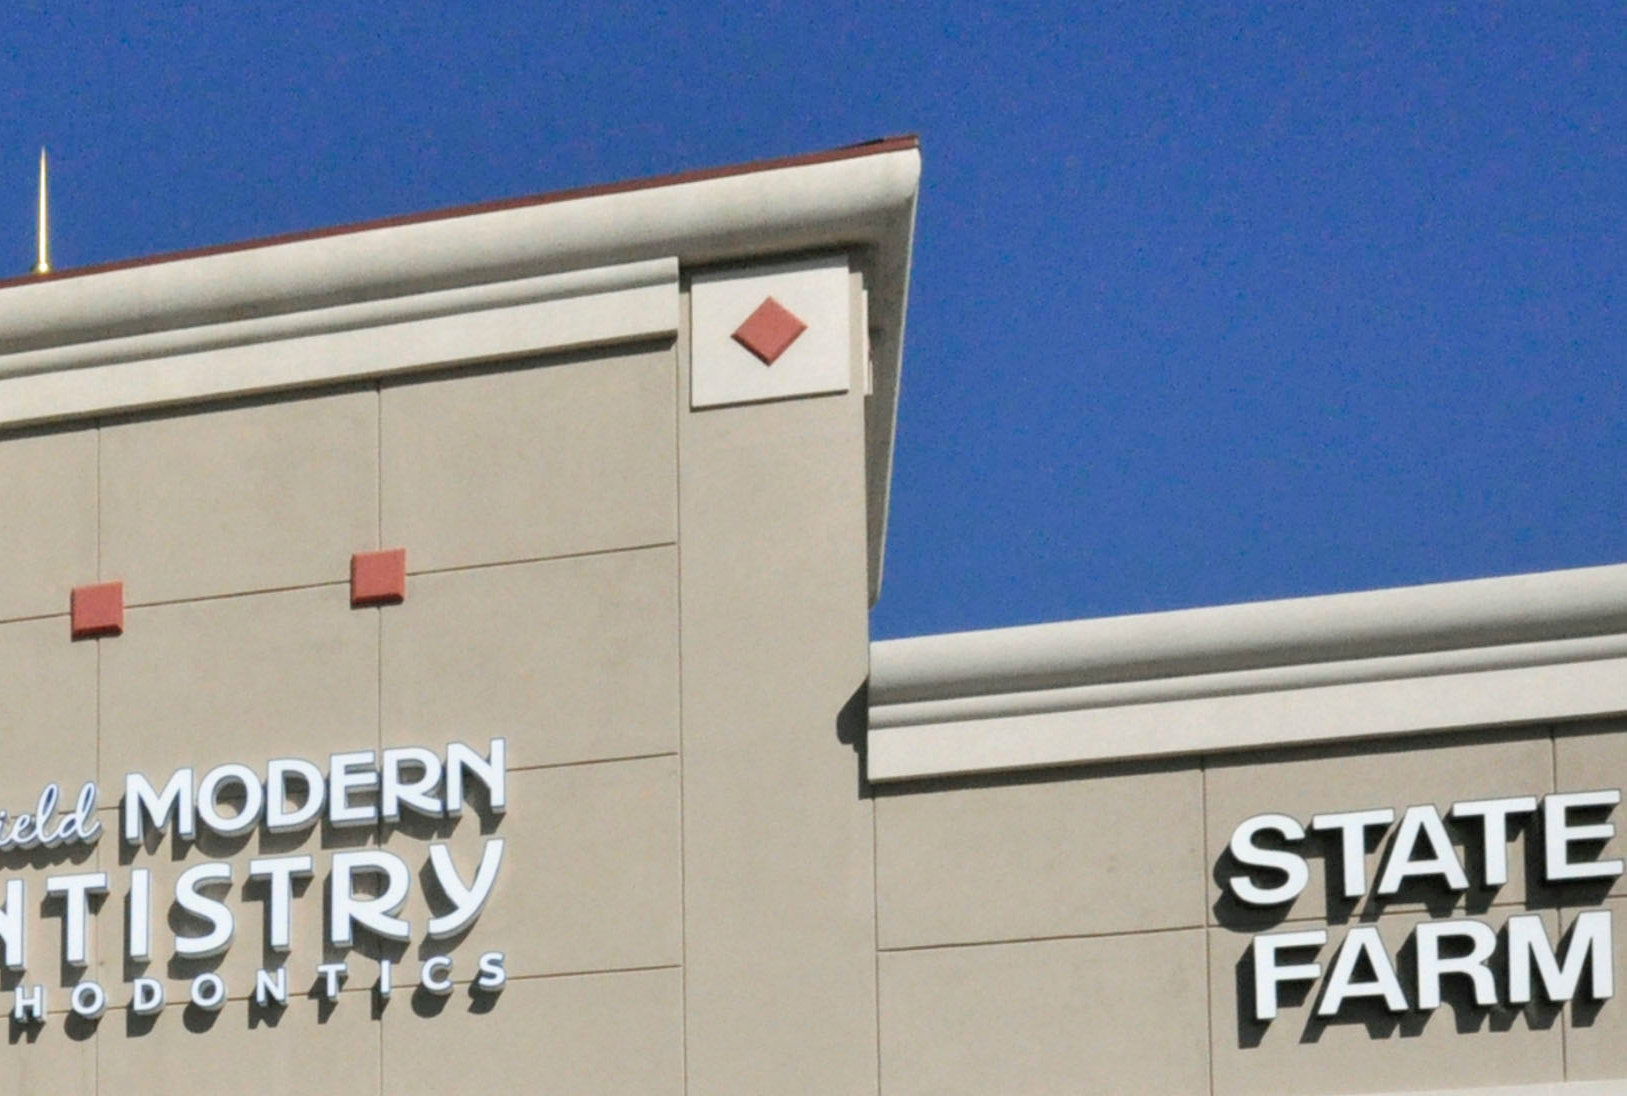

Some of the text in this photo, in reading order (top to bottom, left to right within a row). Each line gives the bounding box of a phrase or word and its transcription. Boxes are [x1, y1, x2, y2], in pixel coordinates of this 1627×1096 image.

[125, 737, 507, 846] MODERN
[1229, 788, 1625, 905] STATE
[1253, 910, 1615, 1021] FARM
